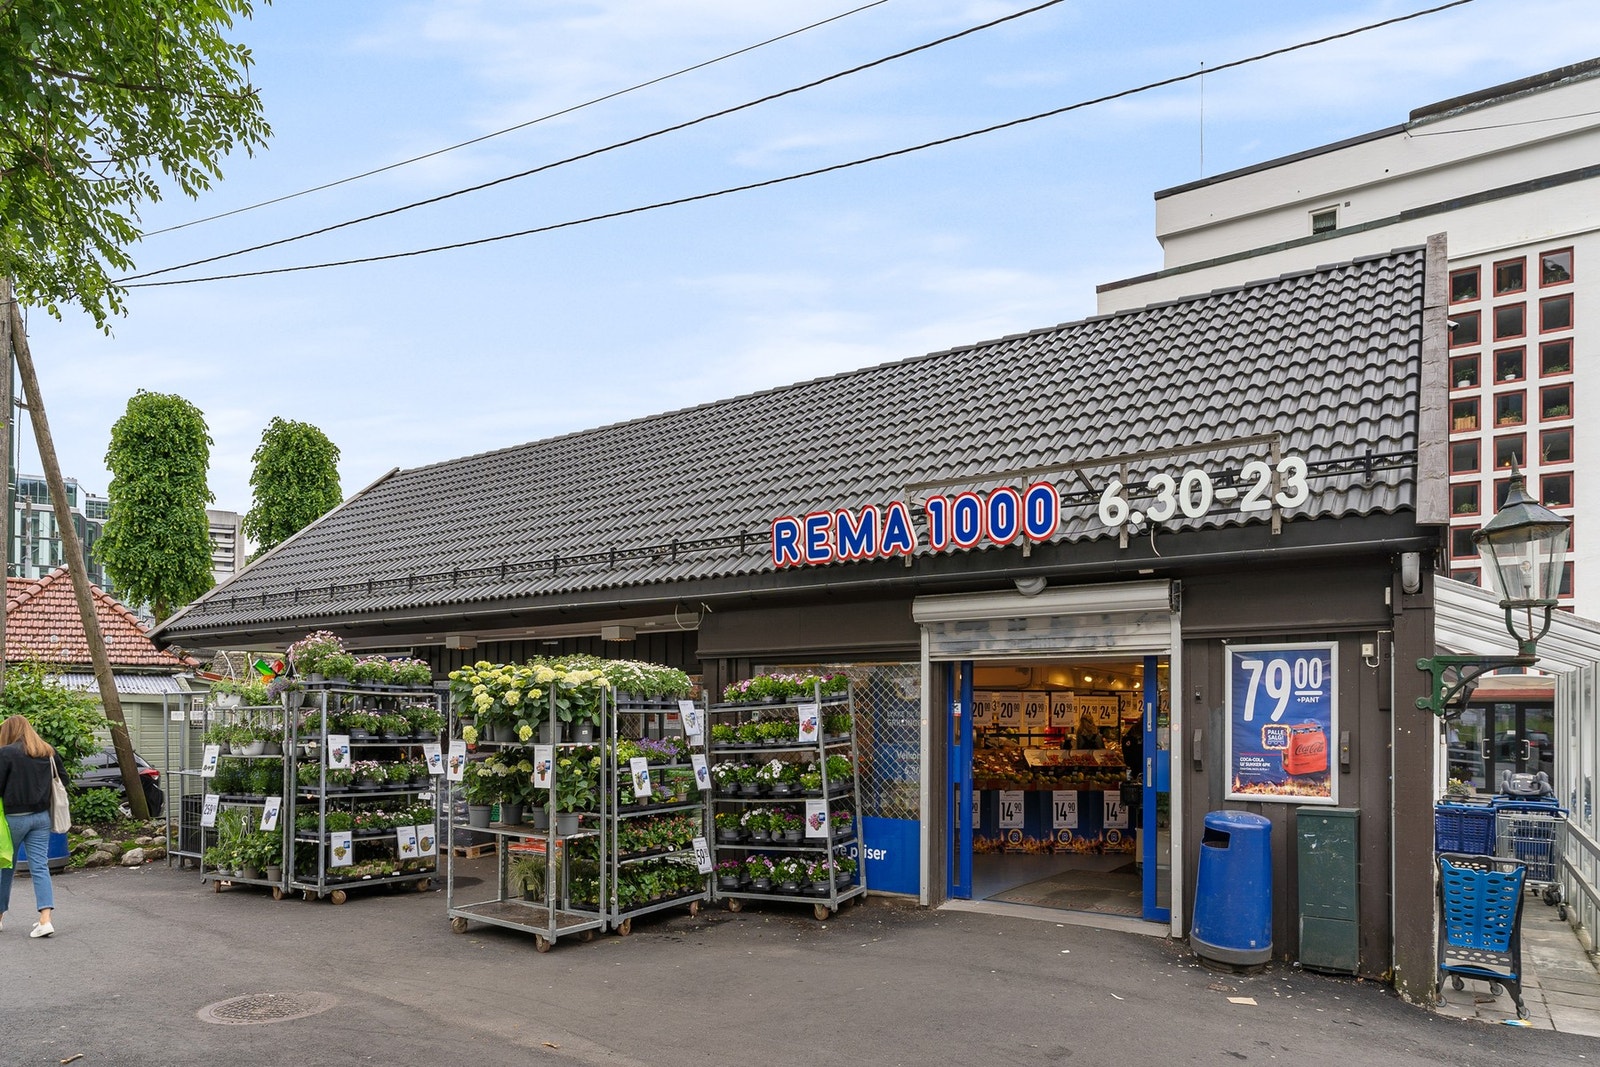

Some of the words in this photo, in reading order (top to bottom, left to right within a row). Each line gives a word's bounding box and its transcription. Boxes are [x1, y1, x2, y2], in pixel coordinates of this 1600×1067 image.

[1098, 456, 1309, 527] 6.30-23
[771, 502, 919, 568] REMA
[925, 481, 1061, 551] 1000
[1242, 658, 1291, 722] 79
[1294, 657, 1322, 689] 00
[1026, 703, 1037, 718] 49
[1054, 703, 1065, 718] 49
[1100, 706, 1110, 719] 24
[1001, 802, 1013, 821] 14
[1014, 802, 1022, 811] 90
[1055, 802, 1067, 821] 14
[1068, 802, 1075, 811] 90
[1106, 802, 1117, 821] 14
[850, 844, 887, 860] piser
